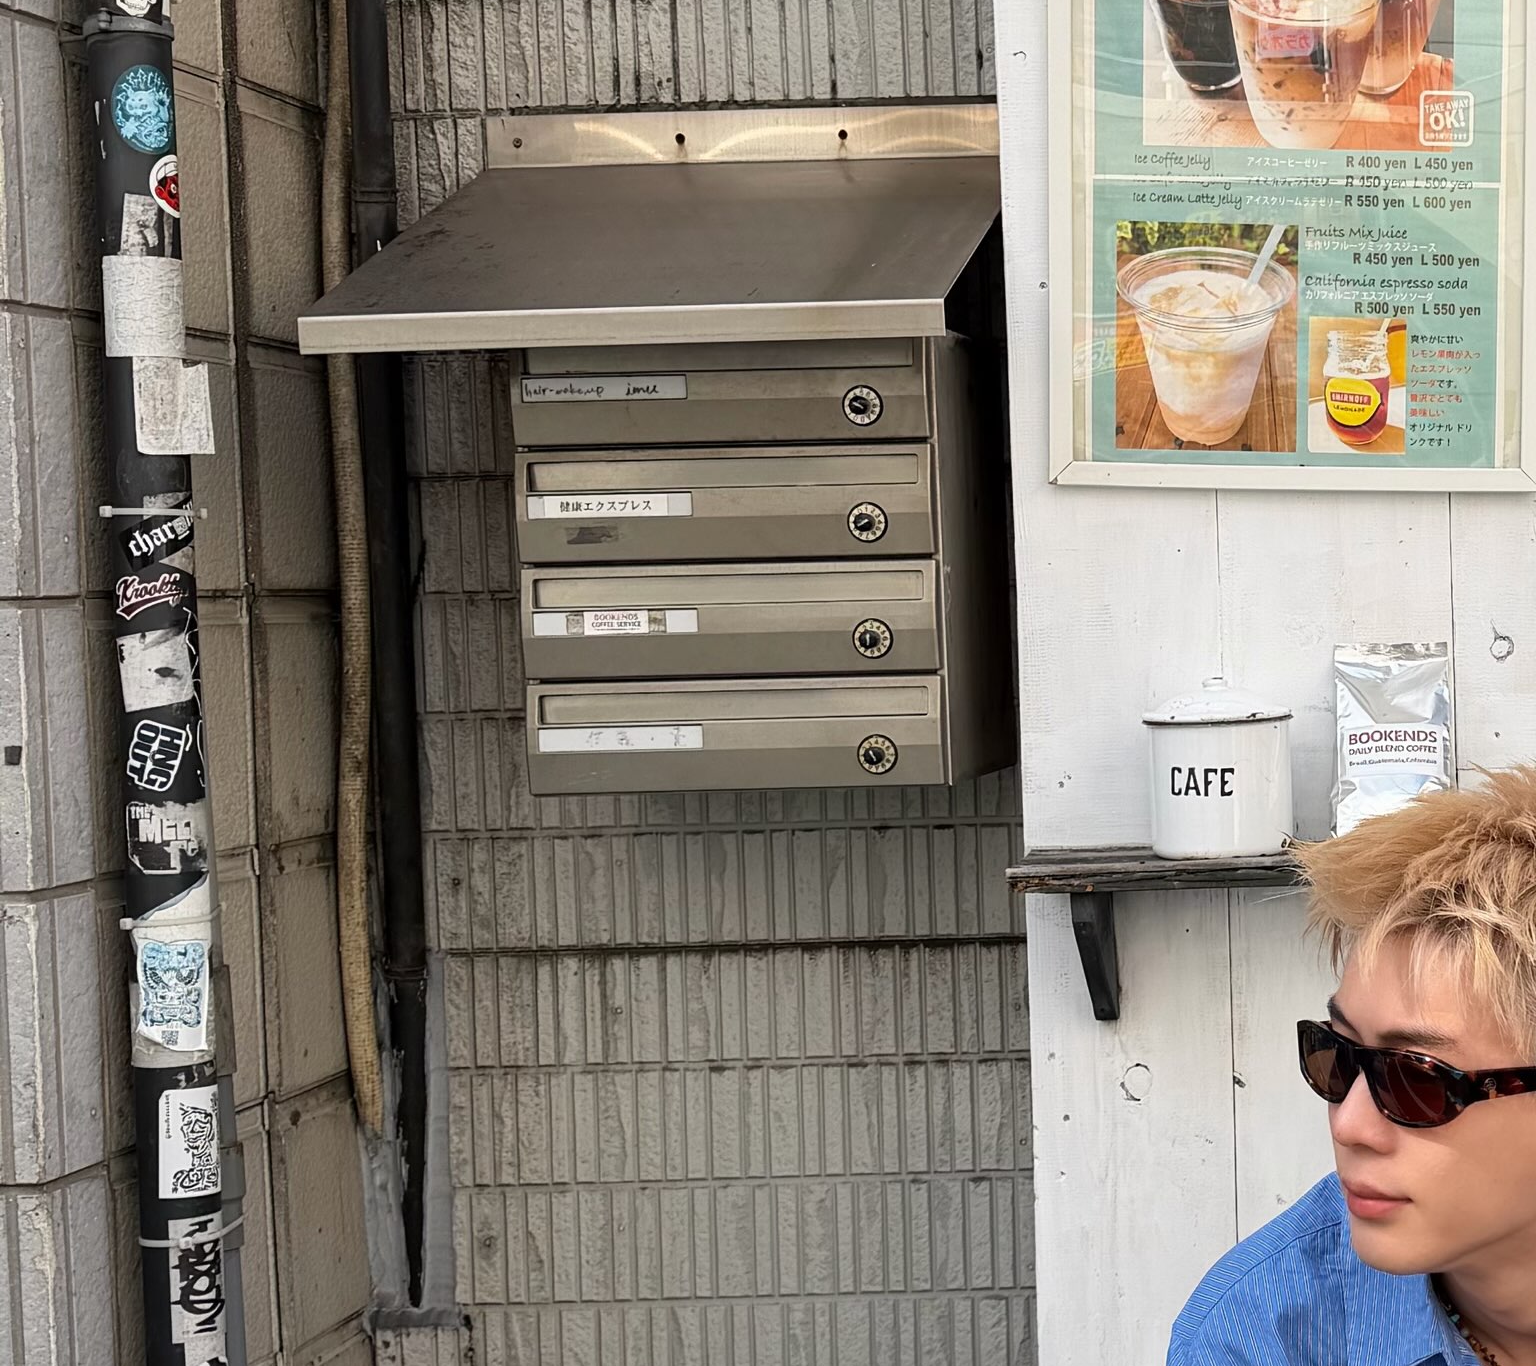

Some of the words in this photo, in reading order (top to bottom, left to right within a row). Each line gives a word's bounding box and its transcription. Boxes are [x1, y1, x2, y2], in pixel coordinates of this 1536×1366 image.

[1429, 108, 1465, 131] OK!
[1134, 154, 1148, 164] Ice
[1150, 151, 1184, 168] Coffee
[1185, 154, 1211, 170] Jelly
[1346, 156, 1354, 167] R
[1358, 156, 1381, 168] 400
[1384, 159, 1406, 171] yen
[1414, 157, 1421, 169] L
[1425, 157, 1447, 170] 450
[1451, 161, 1473, 173] yen
[1305, 224, 1345, 238] Fruits
[1350, 225, 1373, 239] Mix
[1373, 225, 1408, 242] Juice
[1304, 273, 1375, 292] California
[1380, 277, 1433, 293] espresso
[1437, 277, 1468, 289] soda
[1354, 302, 1362, 314] R
[1366, 302, 1389, 314] 500
[1392, 305, 1414, 317] yen
[1422, 303, 1429, 314] L
[1433, 303, 1455, 315] 550
[1459, 306, 1481, 318] yen
[559, 500, 652, 513] 健康エクスプレス
[1348, 729, 1437, 746] BOOKENDS
[1170, 766, 1235, 797] CAFE
